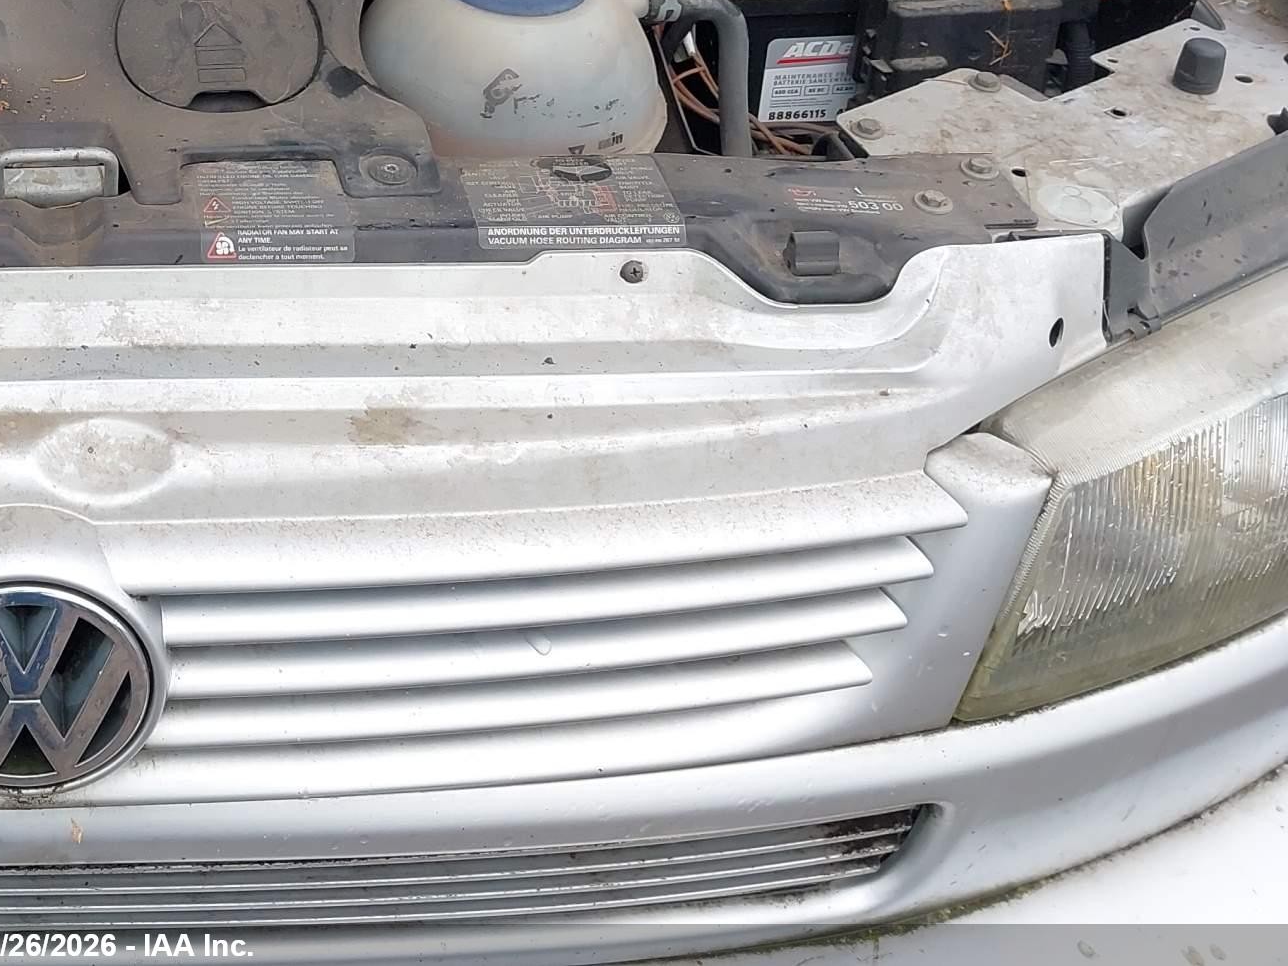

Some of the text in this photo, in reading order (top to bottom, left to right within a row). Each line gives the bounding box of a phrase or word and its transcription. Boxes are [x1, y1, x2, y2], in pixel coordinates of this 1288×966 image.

[774, 72, 832, 81] MAINTENANCE
[768, 109, 827, 120] 88866115
[848, 200, 879, 210] 503
[882, 202, 904, 211] 00
[488, 226, 680, 236] ANORDNUNG DER UNTERDRUCKLEITUNGEN
[488, 236, 528, 245] VACUUM
[529, 236, 554, 244] HOSE
[556, 236, 598, 244] ROUTING
[599, 235, 642, 244] DIAGRAM
[323, 245, 339, 253] peut
